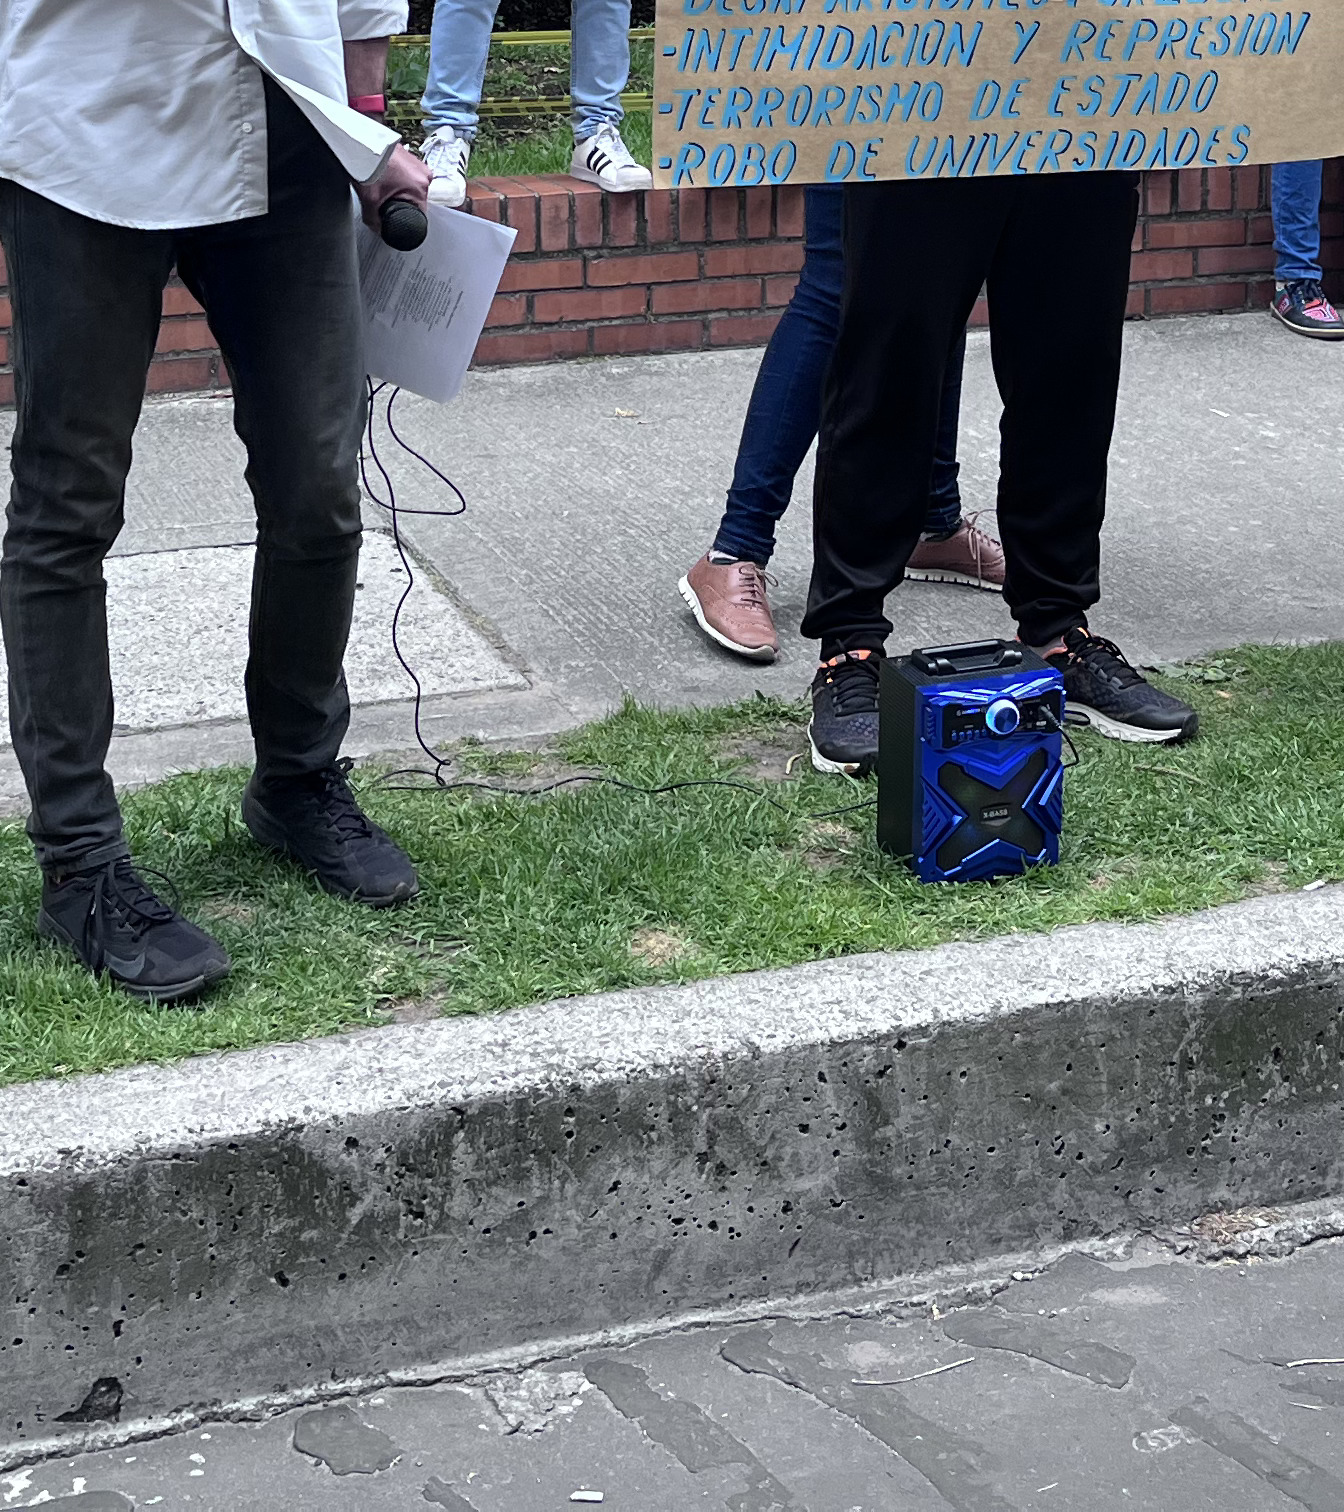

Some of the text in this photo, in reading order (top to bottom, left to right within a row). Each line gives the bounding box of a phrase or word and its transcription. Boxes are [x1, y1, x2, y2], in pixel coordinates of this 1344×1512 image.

[1013, 20, 1040, 65] Y
[1061, 12, 1311, 63] REPRESION
[970, 76, 1030, 121] DE
[1046, 70, 1219, 118] ESTADO
[827, 135, 885, 180] DE
[904, 124, 1252, 179] UNIVERSIDADES
